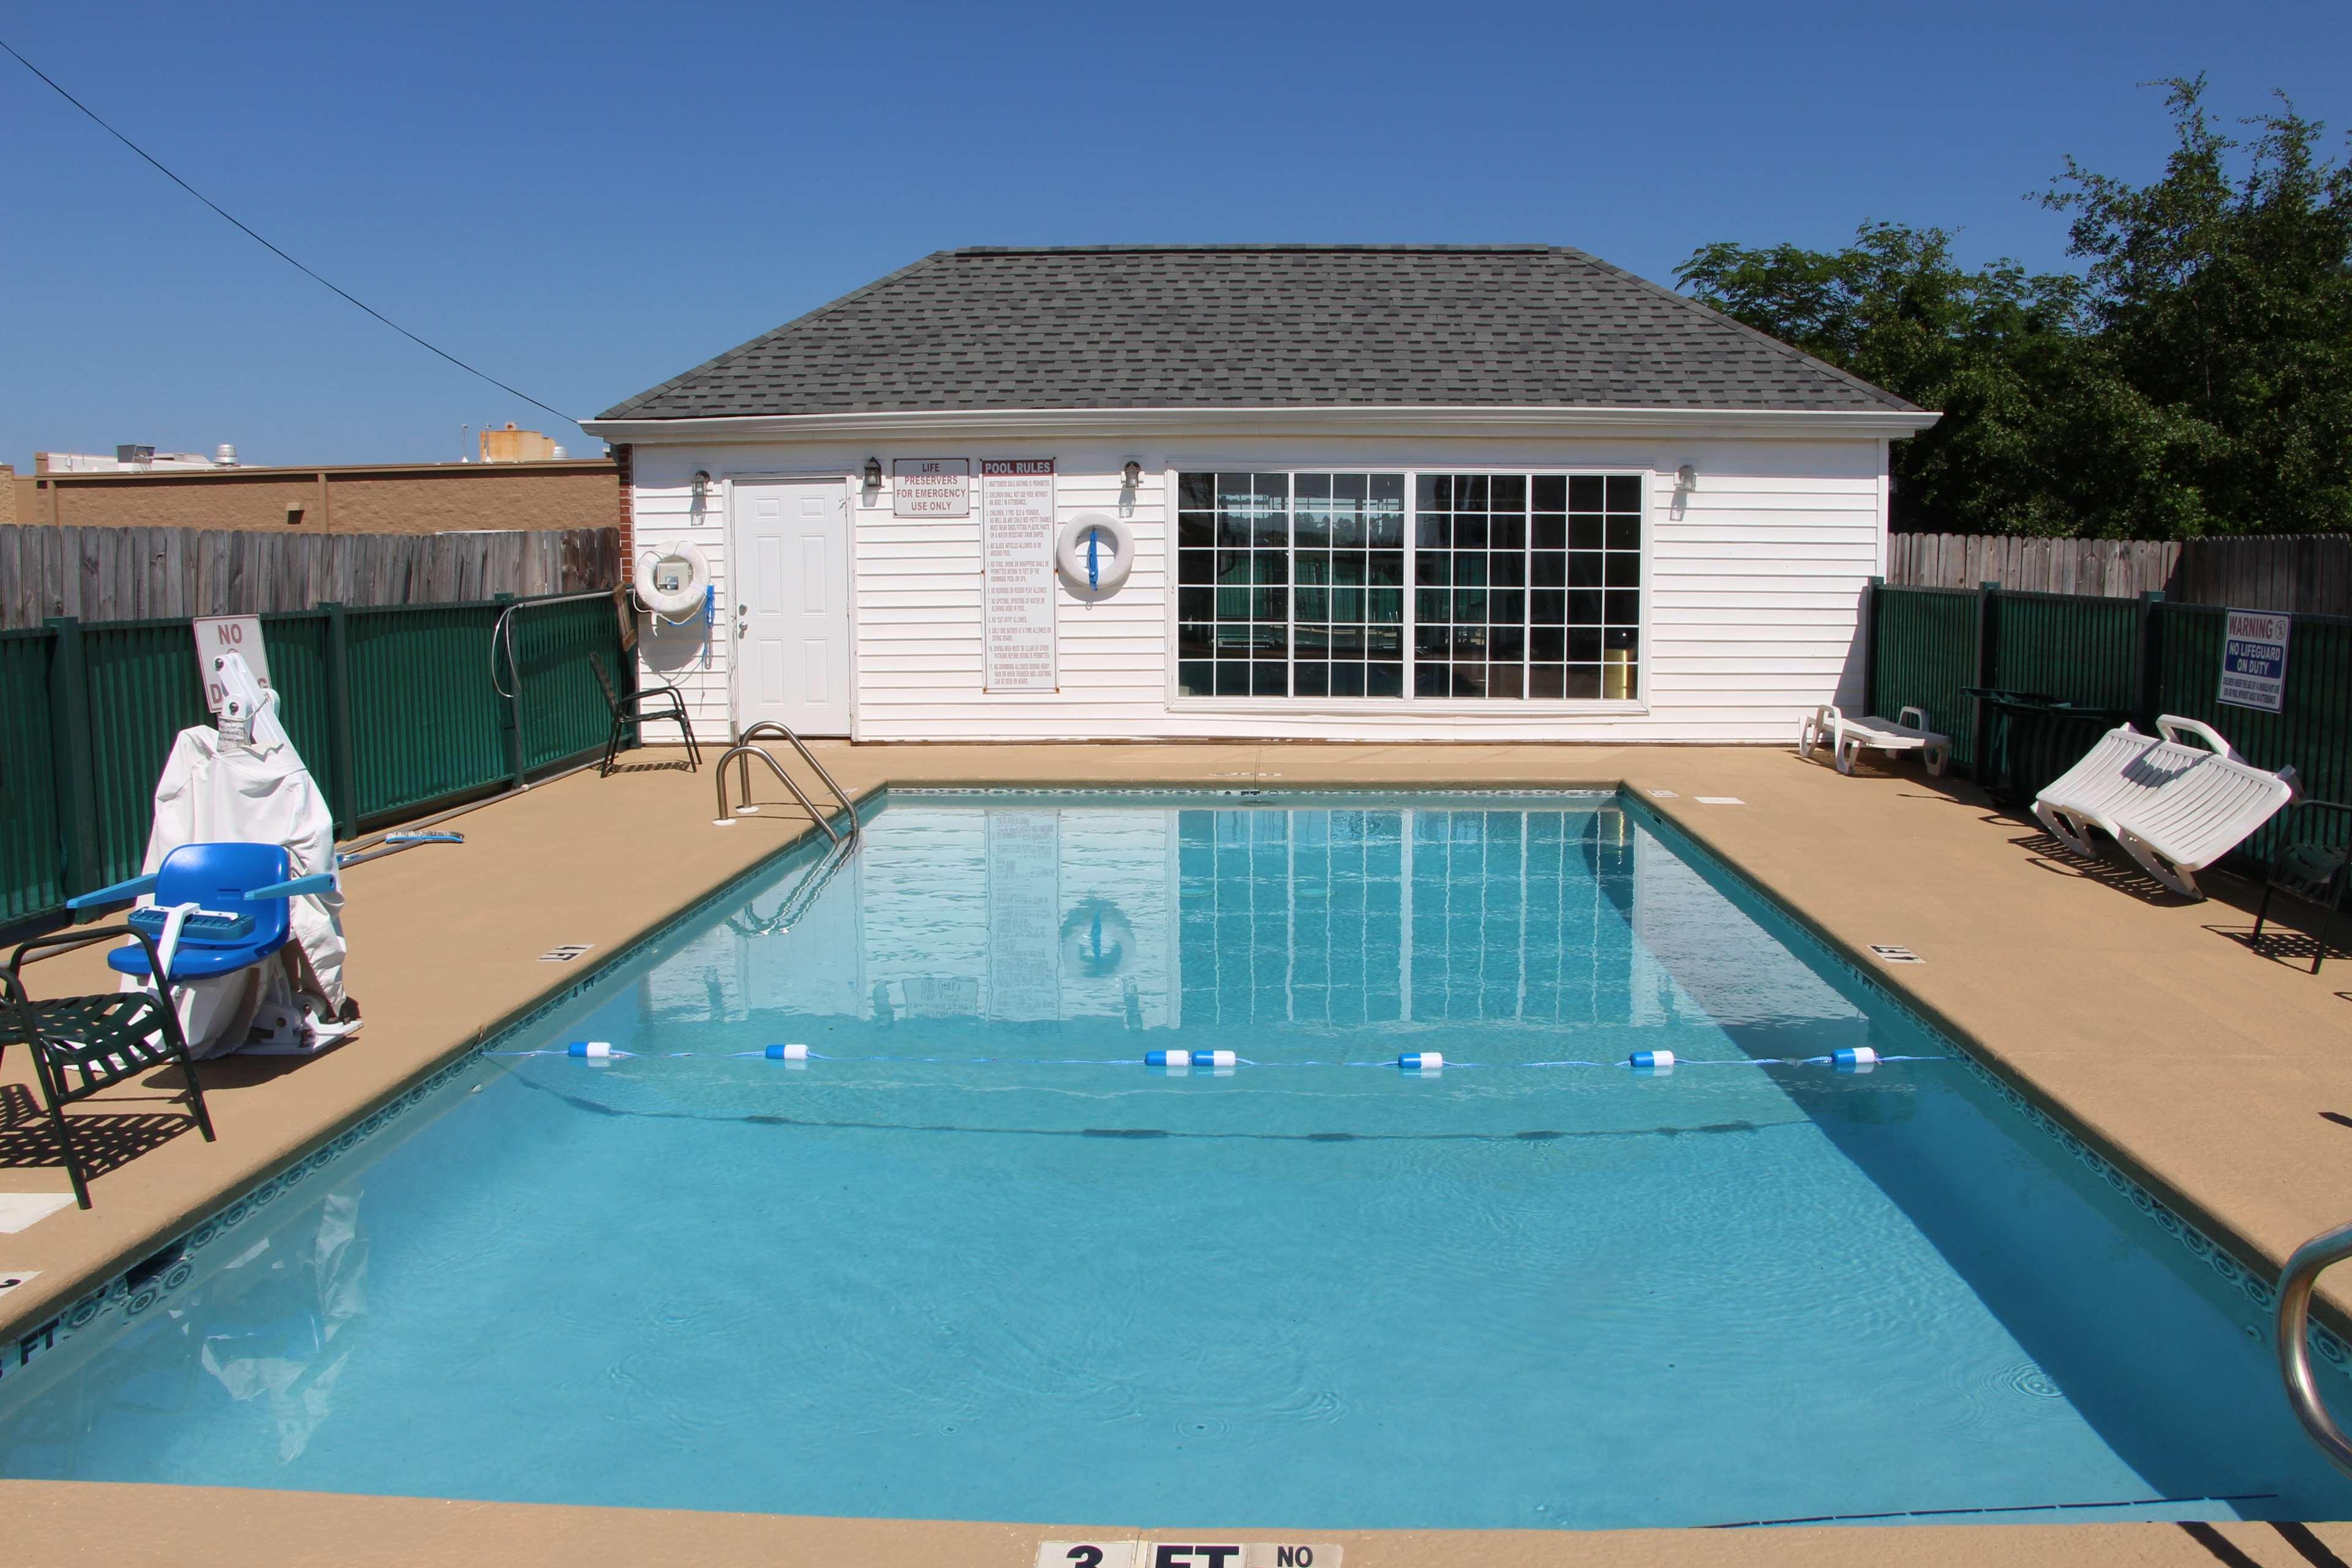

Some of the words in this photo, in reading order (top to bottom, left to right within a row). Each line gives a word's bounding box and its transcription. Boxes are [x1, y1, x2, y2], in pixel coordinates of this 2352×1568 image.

[922, 463, 940, 472] LIFE
[986, 463, 1013, 473] POOL
[1017, 462, 1050, 473] RULES
[905, 476, 957, 485] PRESERVERS
[897, 489, 913, 498] FOR
[916, 489, 965, 497] EMERGENCY
[911, 502, 927, 511] USE
[930, 502, 951, 511] ONLY
[217, 624, 243, 645] NO
[2229, 616, 2273, 639] WARNING
[2229, 643, 2239, 655] NO
[2241, 644, 2280, 661] LIFEGUARD
[2237, 658, 2247, 672] ON
[2249, 660, 2269, 675] DUTY
[20, 1317, 60, 1366] FT
[1156, 1545, 1239, 1568] FT
[1277, 1545, 1313, 1568] NO
